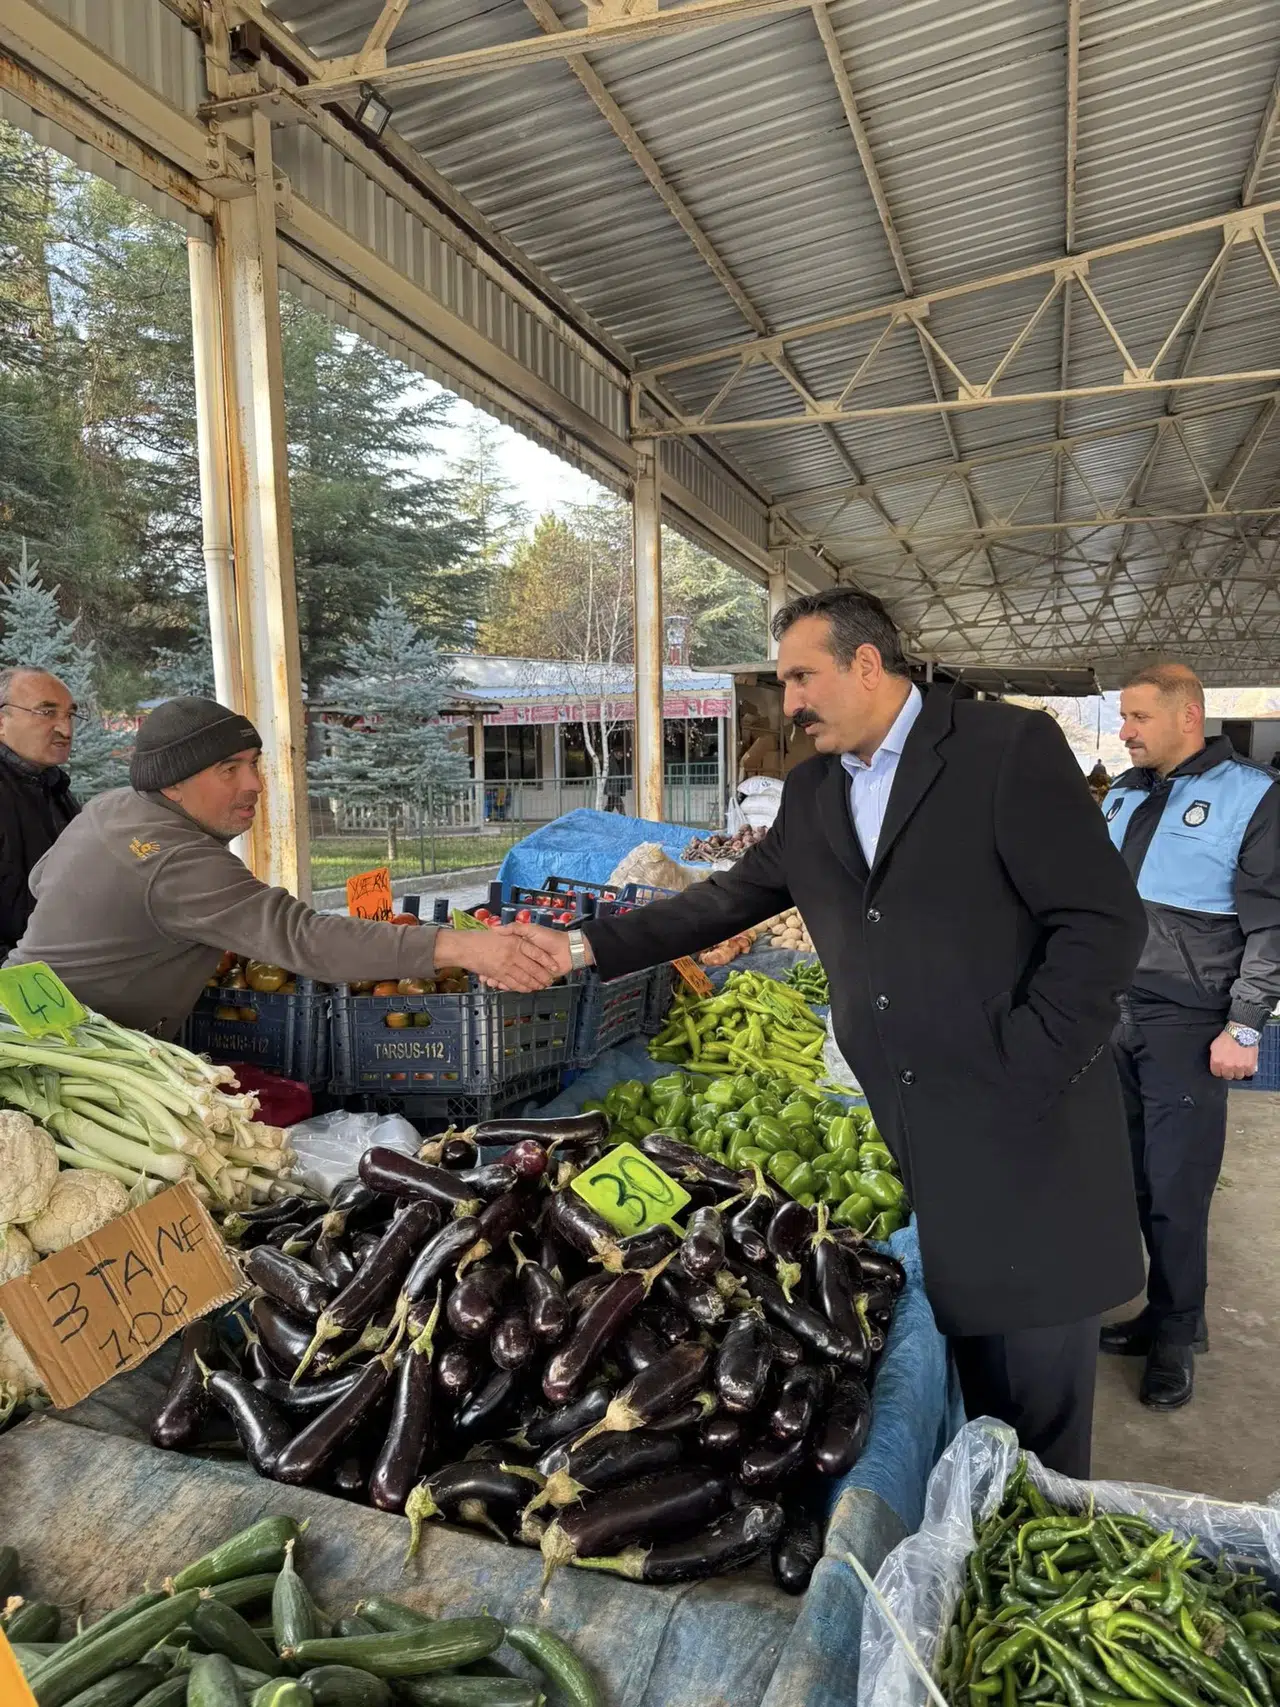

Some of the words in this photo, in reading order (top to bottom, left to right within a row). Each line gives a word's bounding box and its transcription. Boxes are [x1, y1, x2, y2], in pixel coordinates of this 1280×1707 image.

[18, 972, 65, 1024] 40
[374, 1041, 444, 1060] TARSUS-112
[589, 1155, 675, 1227] 30
[47, 1281, 89, 1344] 3
[86, 1214, 203, 1306] TANE
[99, 1285, 188, 1369] 100
